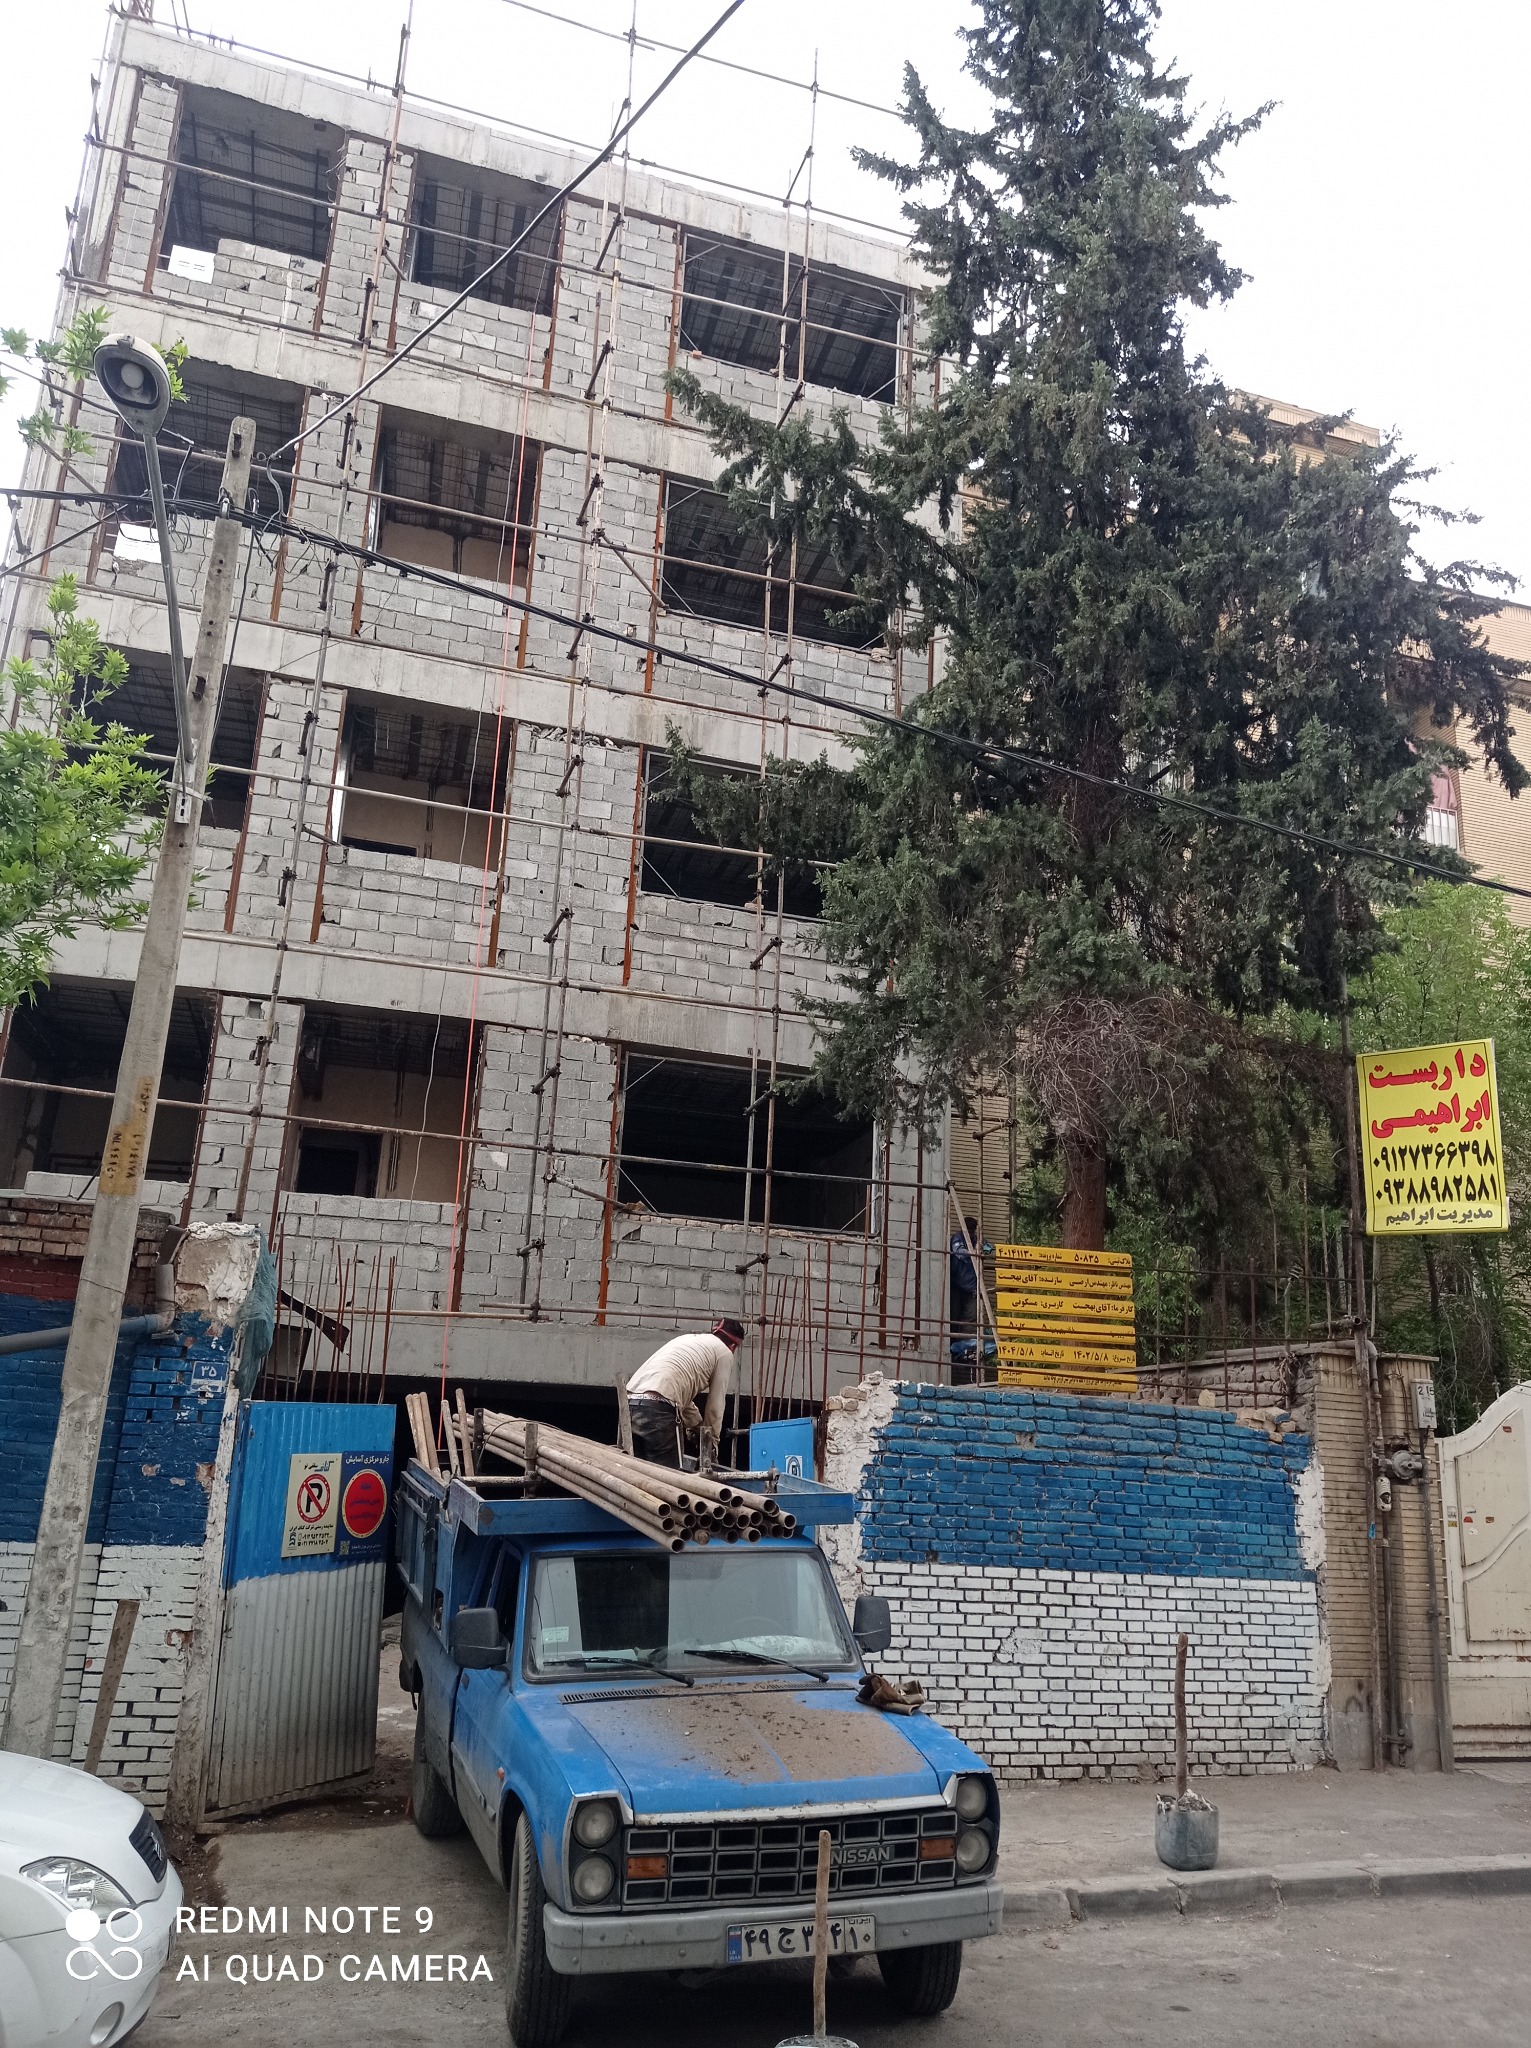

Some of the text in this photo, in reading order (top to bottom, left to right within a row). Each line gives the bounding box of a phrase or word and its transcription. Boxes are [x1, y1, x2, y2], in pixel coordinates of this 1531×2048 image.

[1368, 1048, 1486, 1090] داربست
[1371, 1090, 1491, 1138] ابراهیمی
[1373, 1139, 1495, 1172] ۰۹۱۲۷۳۶۶۳۹۸
[1375, 1173, 1498, 1205] ۰۹۳۸۸۹۸۲۵۸۱
[1386, 1207, 1493, 1226] مدیریت ابراهیم
[1074, 1253, 1099, 1263] ۵۰۸۳۵
[201, 1365, 217, 1377] ۳۵
[830, 1846, 891, 1865] NISSAN
[801, 1923, 842, 1953] ۳۴
